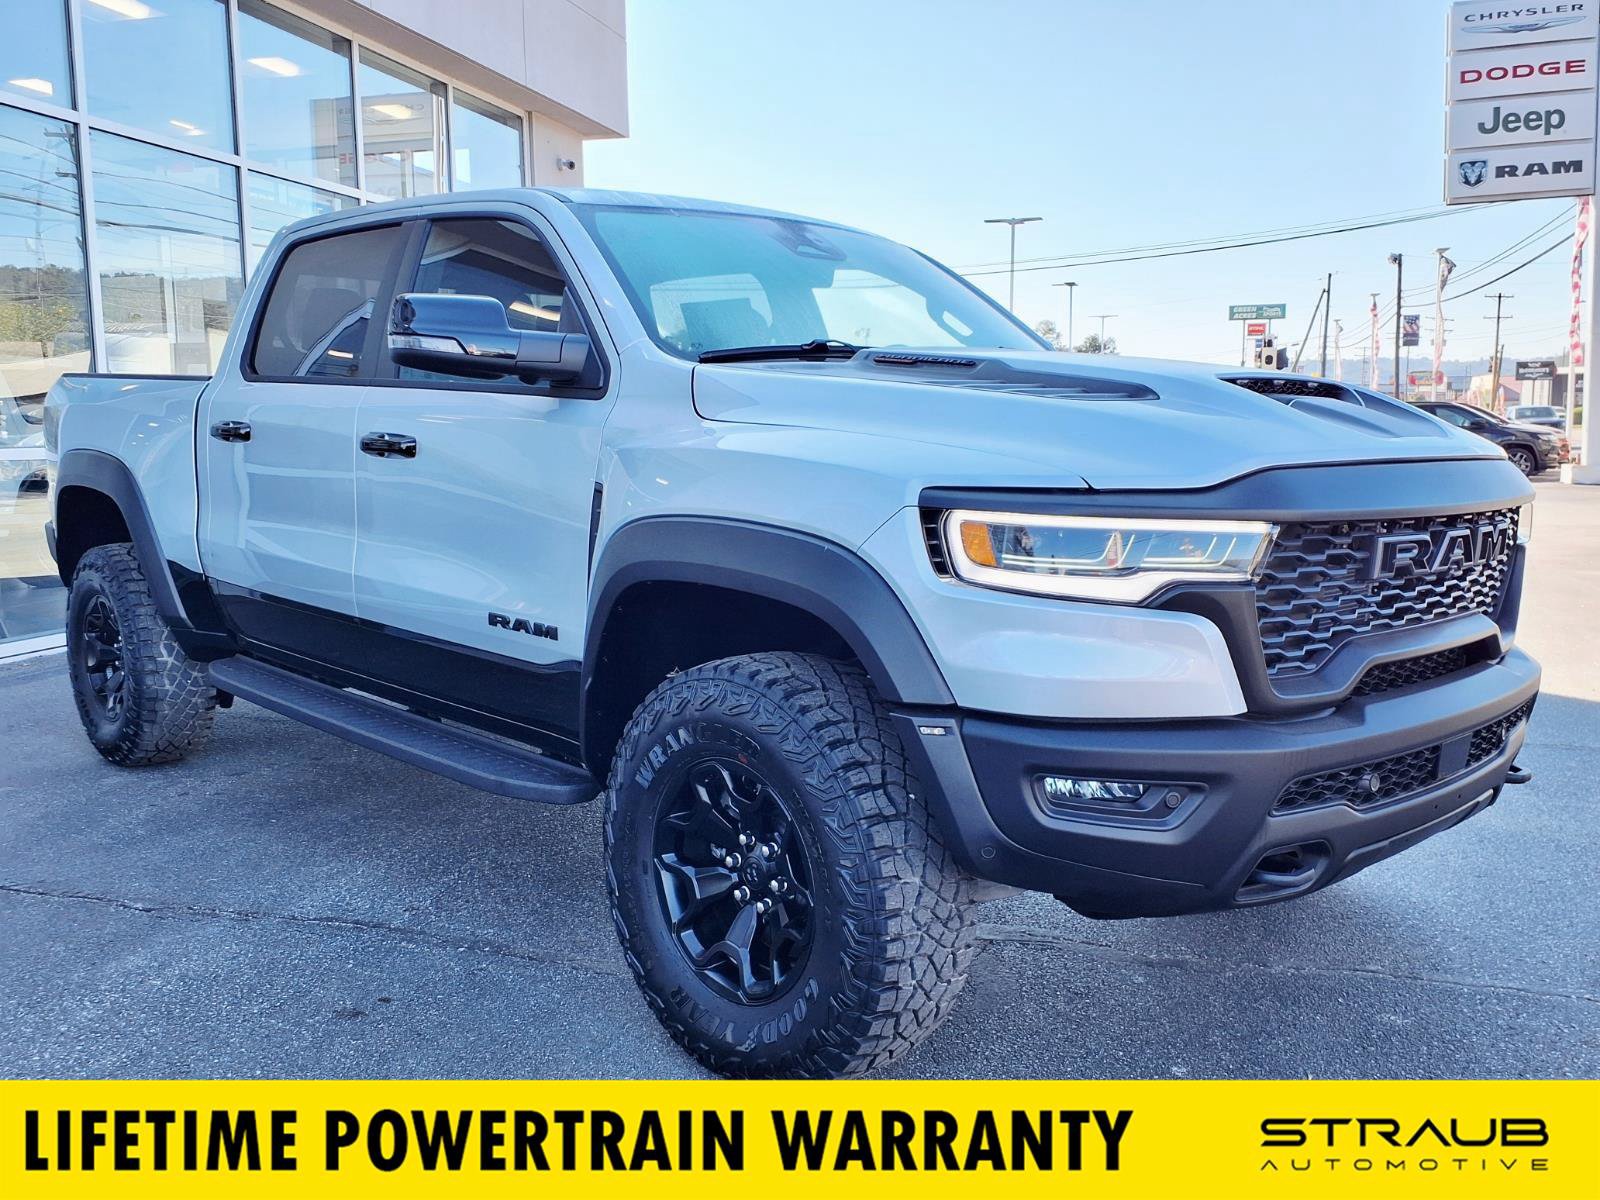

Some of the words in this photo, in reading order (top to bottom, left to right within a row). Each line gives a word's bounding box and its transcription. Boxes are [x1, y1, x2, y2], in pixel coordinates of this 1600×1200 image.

[1463, 4, 1584, 22] CHRYSLER
[1460, 59, 1586, 84] DODGE
[1477, 106, 1566, 135] Jeep
[1494, 159, 1583, 179] RAM
[1374, 524, 1509, 579] RAM
[488, 611, 559, 641] RAM
